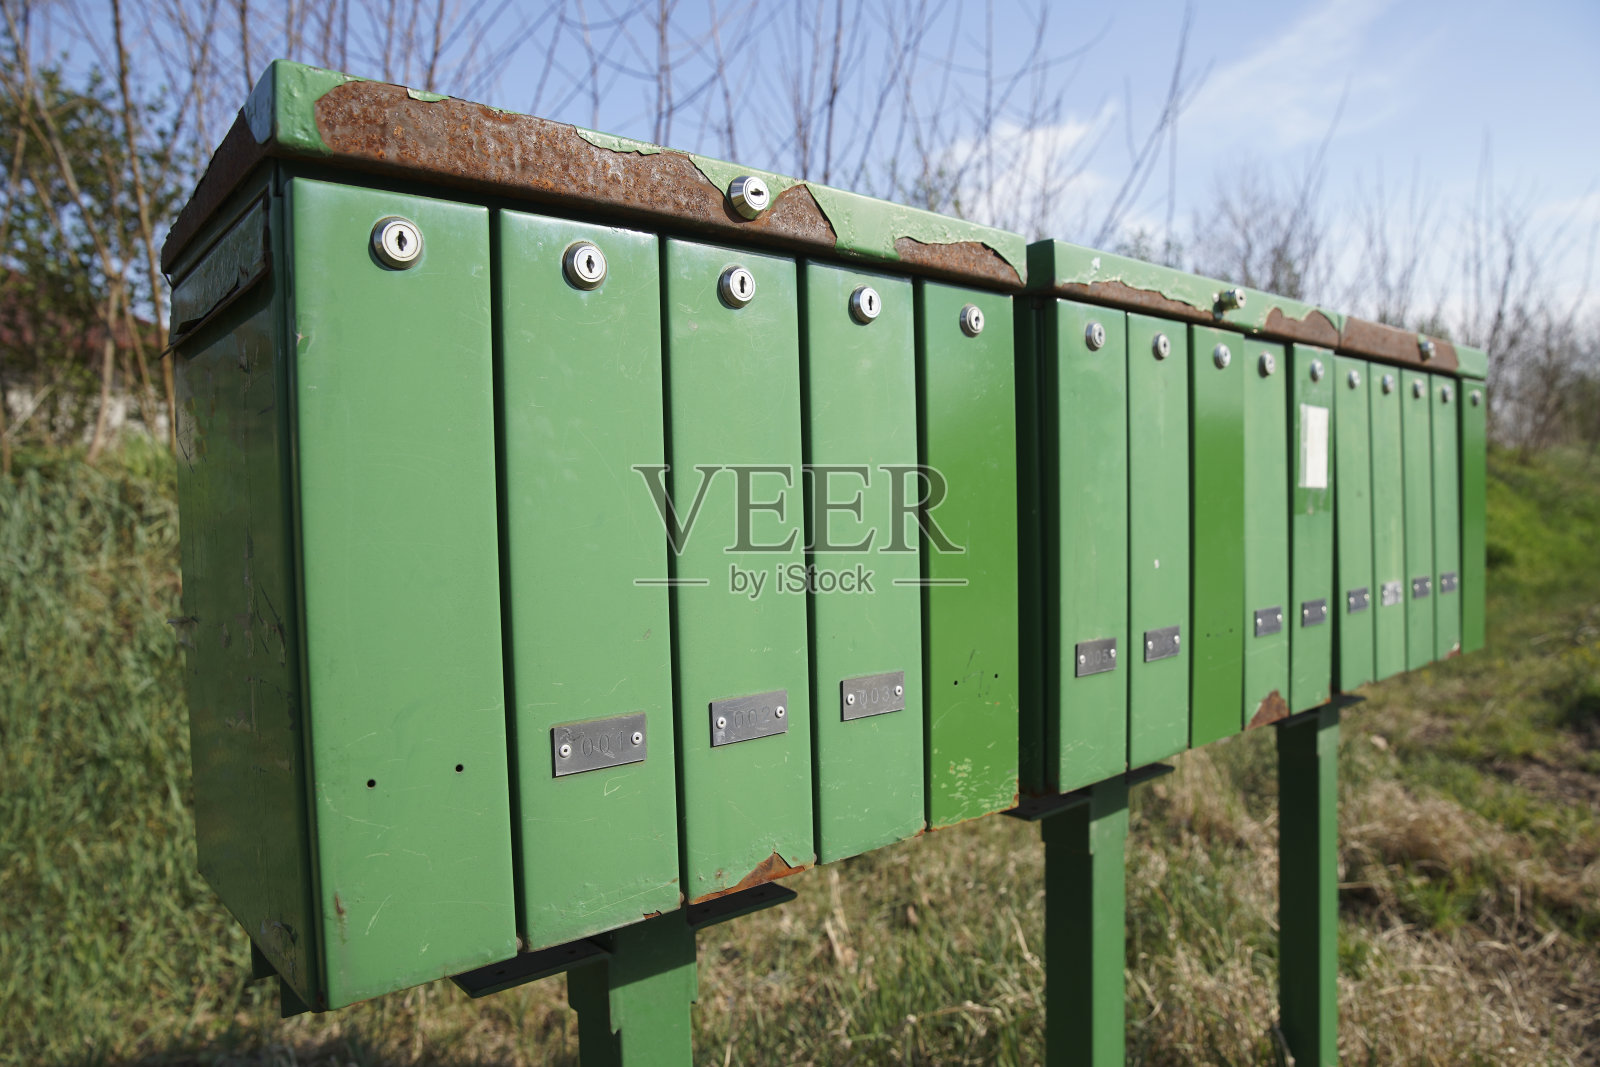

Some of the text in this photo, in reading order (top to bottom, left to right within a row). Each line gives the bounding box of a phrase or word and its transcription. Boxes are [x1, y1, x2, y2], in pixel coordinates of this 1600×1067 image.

[859, 686, 890, 706] 003
[734, 706, 771, 729] 002
[582, 731, 624, 758] 001
